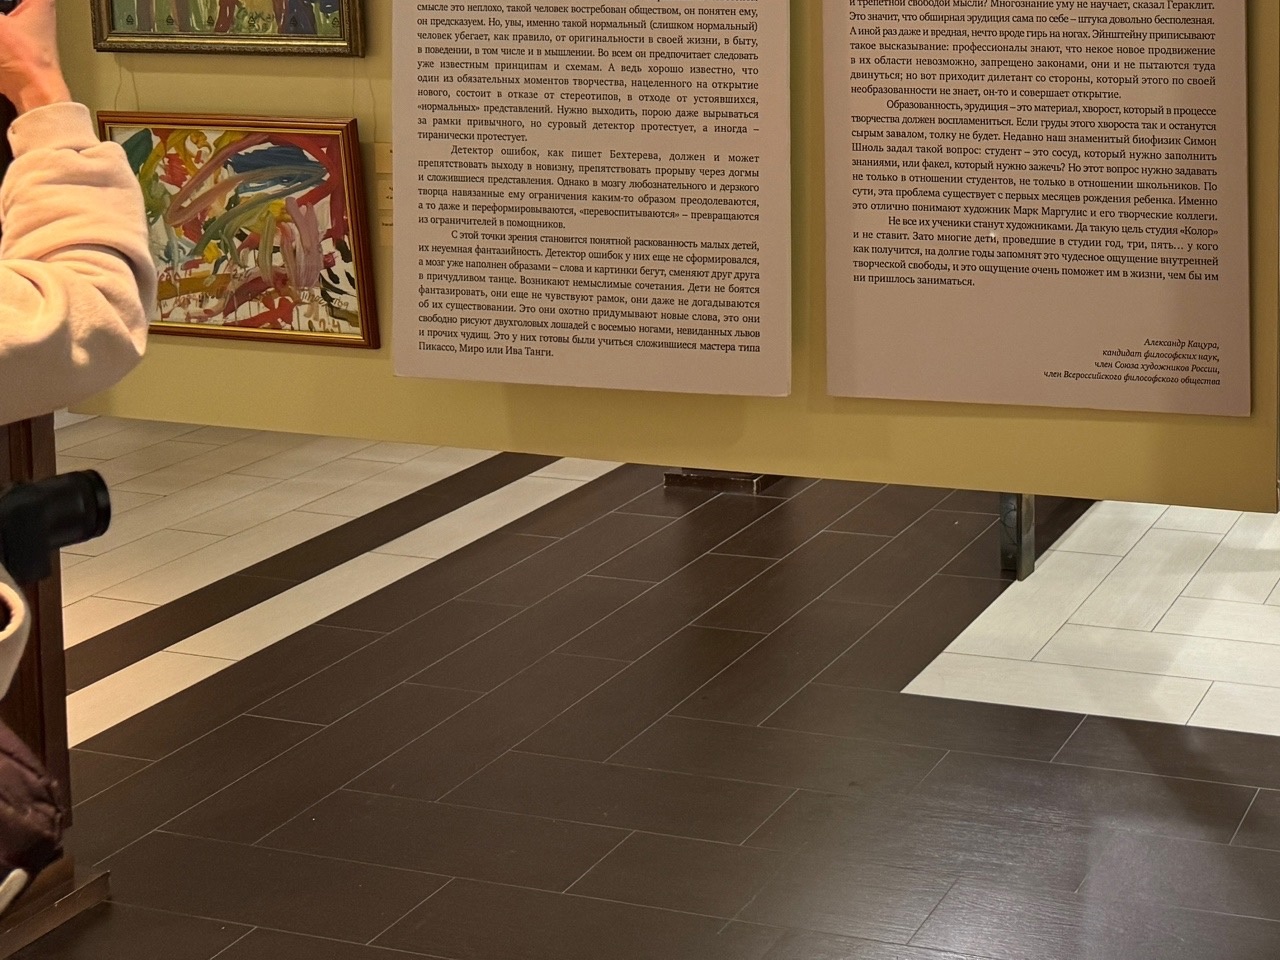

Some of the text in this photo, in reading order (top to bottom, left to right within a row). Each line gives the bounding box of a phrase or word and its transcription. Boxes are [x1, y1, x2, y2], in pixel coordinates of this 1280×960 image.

[426, 273, 486, 283] причудливом
[488, 276, 517, 284] танце.
[519, 275, 571, 286] Возникают
[572, 280, 632, 289] немыслимые
[634, 283, 685, 291] сочетания.
[687, 283, 711, 293] Дети
[728, 284, 760, 294] боятся
[867, 275, 916, 284] пришлось
[916, 277, 975, 286] заниматься.
[418, 341, 458, 353] Пикассо,
[458, 344, 485, 355] Миро
[505, 346, 523, 355] Ива
[524, 347, 554, 356] Танги.
